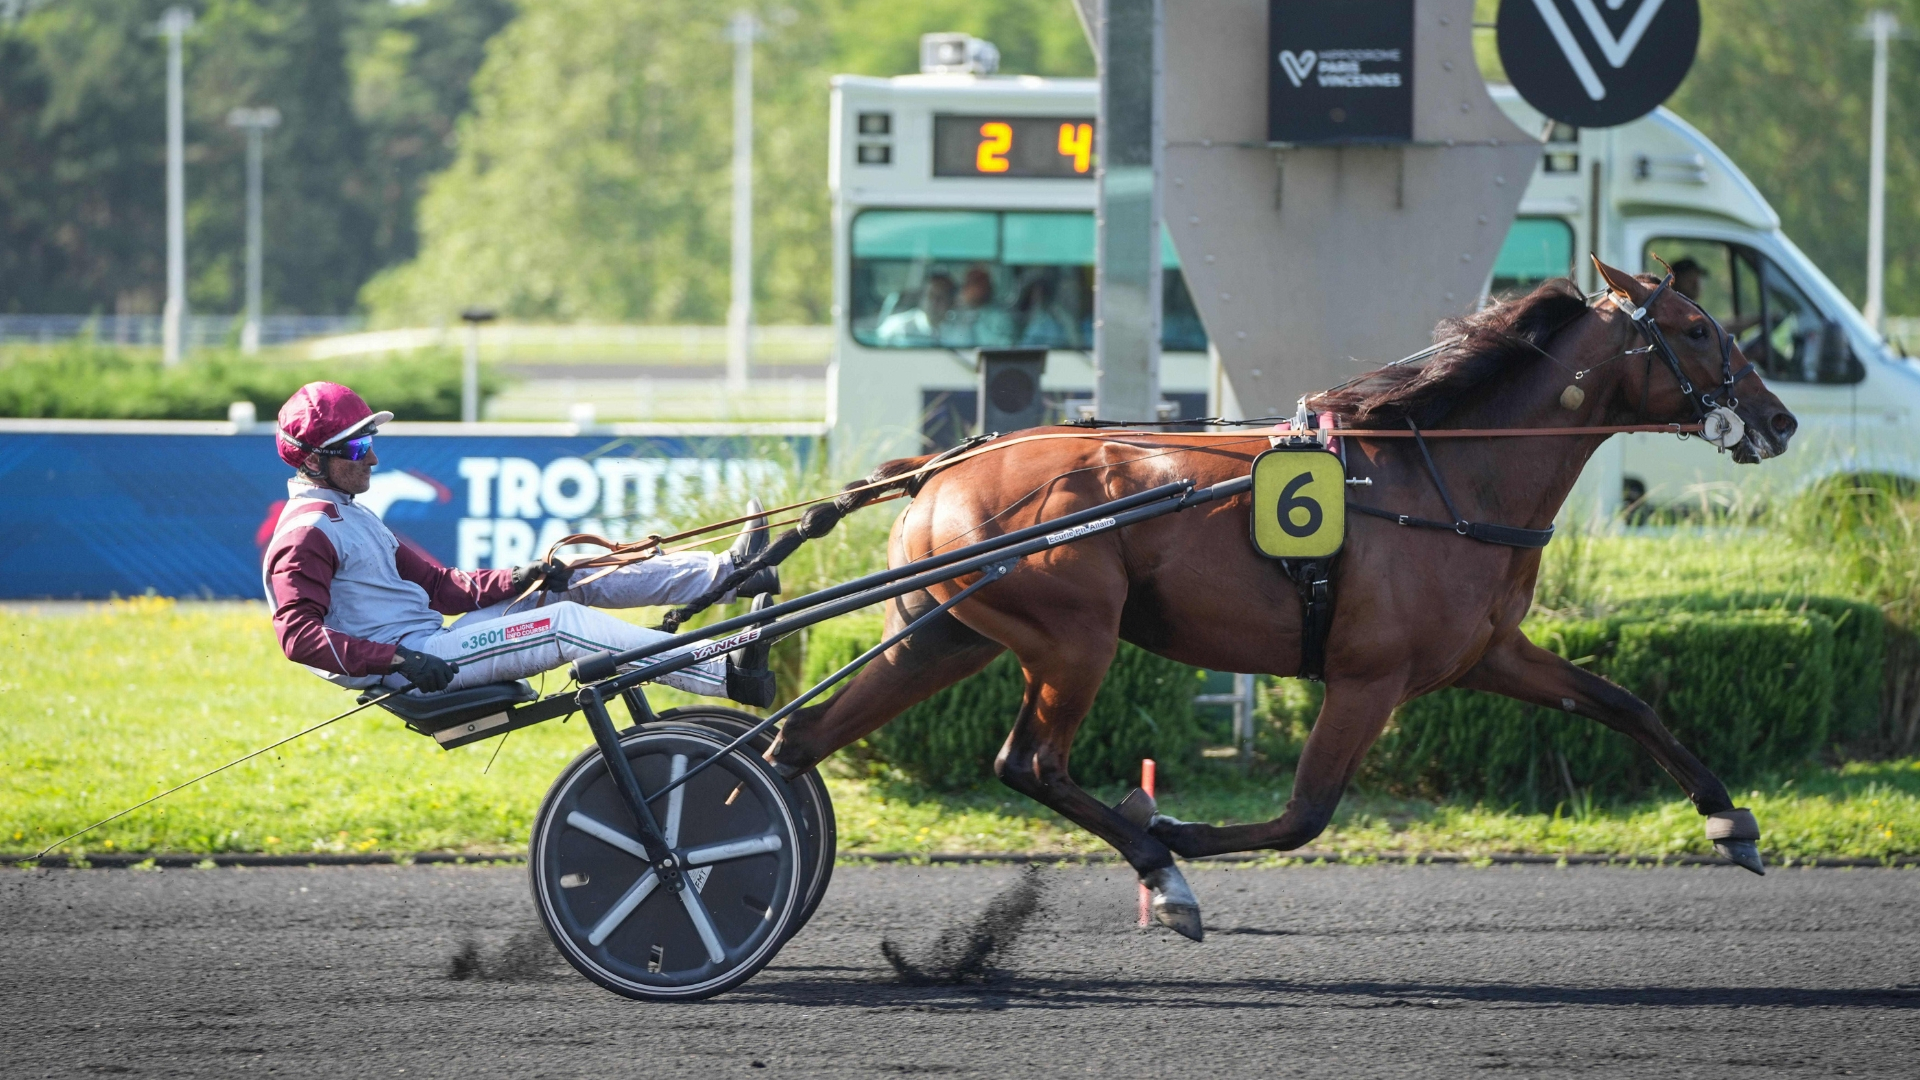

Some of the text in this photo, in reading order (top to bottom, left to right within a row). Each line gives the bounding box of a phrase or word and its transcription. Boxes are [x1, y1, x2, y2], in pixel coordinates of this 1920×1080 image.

[1318, 61, 1360, 73] PARIS
[1318, 72, 1401, 87] VINCENNES
[976, 122, 1093, 173] 2 4
[1277, 471, 1323, 538] 6
[1090, 518, 1115, 530] Allaire
[506, 625, 549, 639] INFO COURSES
[516, 622, 534, 631] LIGNE
[469, 628, 504, 650] 3601
[692, 629, 760, 659] YANKEE
